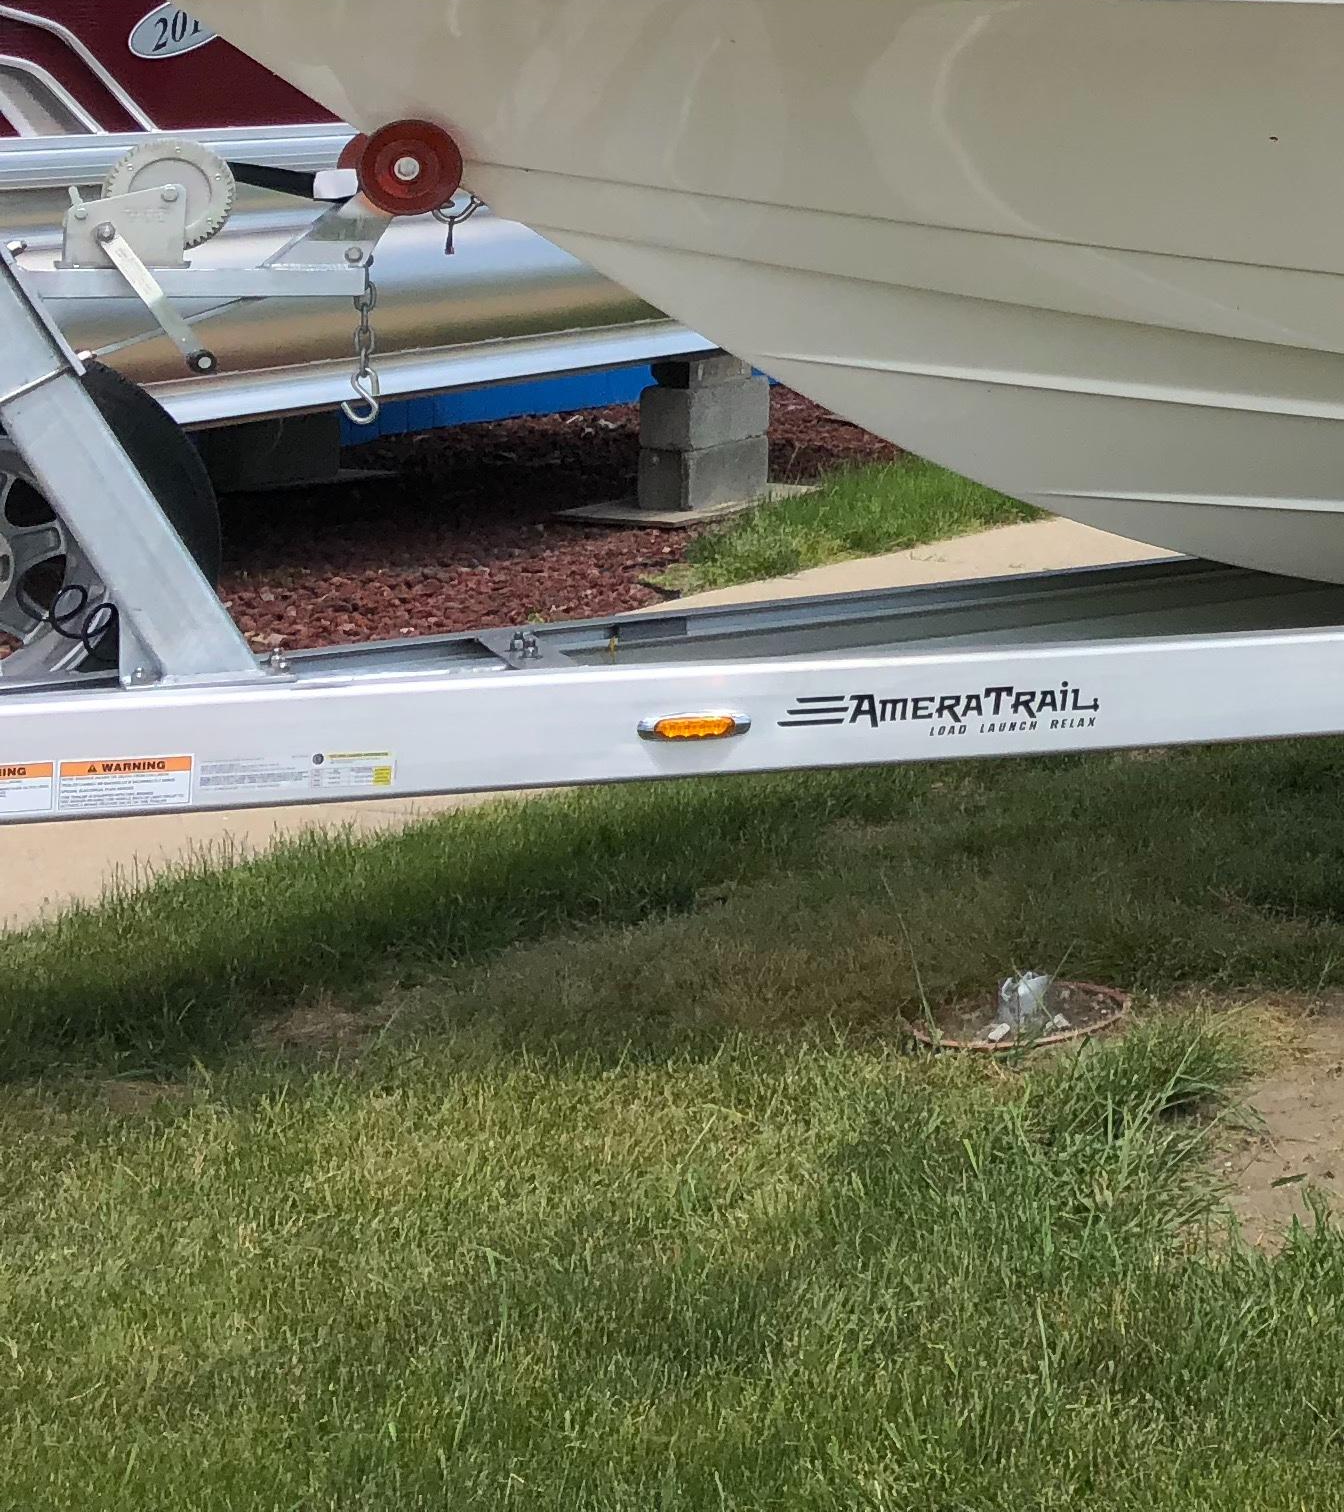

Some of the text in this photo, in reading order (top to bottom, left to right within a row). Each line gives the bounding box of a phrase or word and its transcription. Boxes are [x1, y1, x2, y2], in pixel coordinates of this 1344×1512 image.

[929, 717, 1097, 737] LOAD LAUNCH RELAX
[0, 767, 27, 777] ING
[101, 760, 166, 773] WARNING
